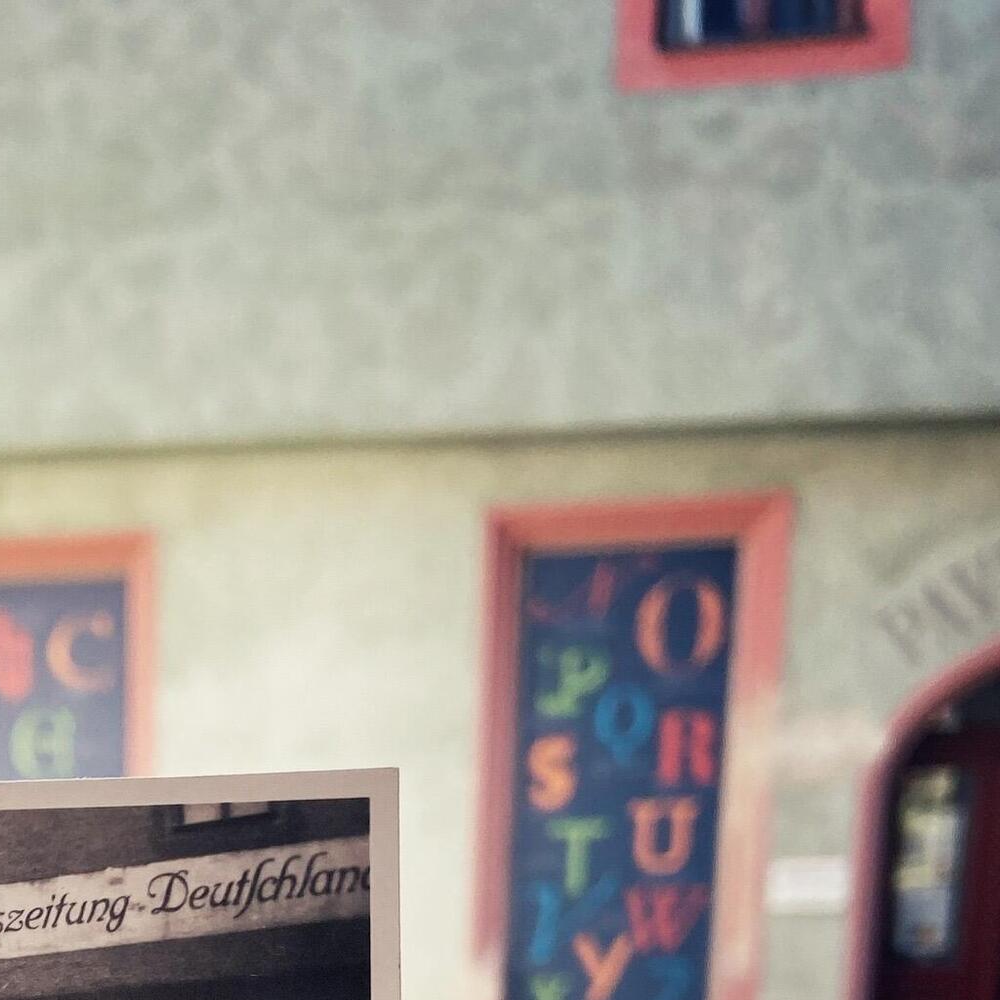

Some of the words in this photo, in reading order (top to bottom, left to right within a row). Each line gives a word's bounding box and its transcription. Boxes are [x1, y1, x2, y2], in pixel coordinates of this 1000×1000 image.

[47, 612, 116, 696] C
[528, 735, 577, 814] S
[548, 814, 611, 898] T
[630, 796, 699, 876] U
